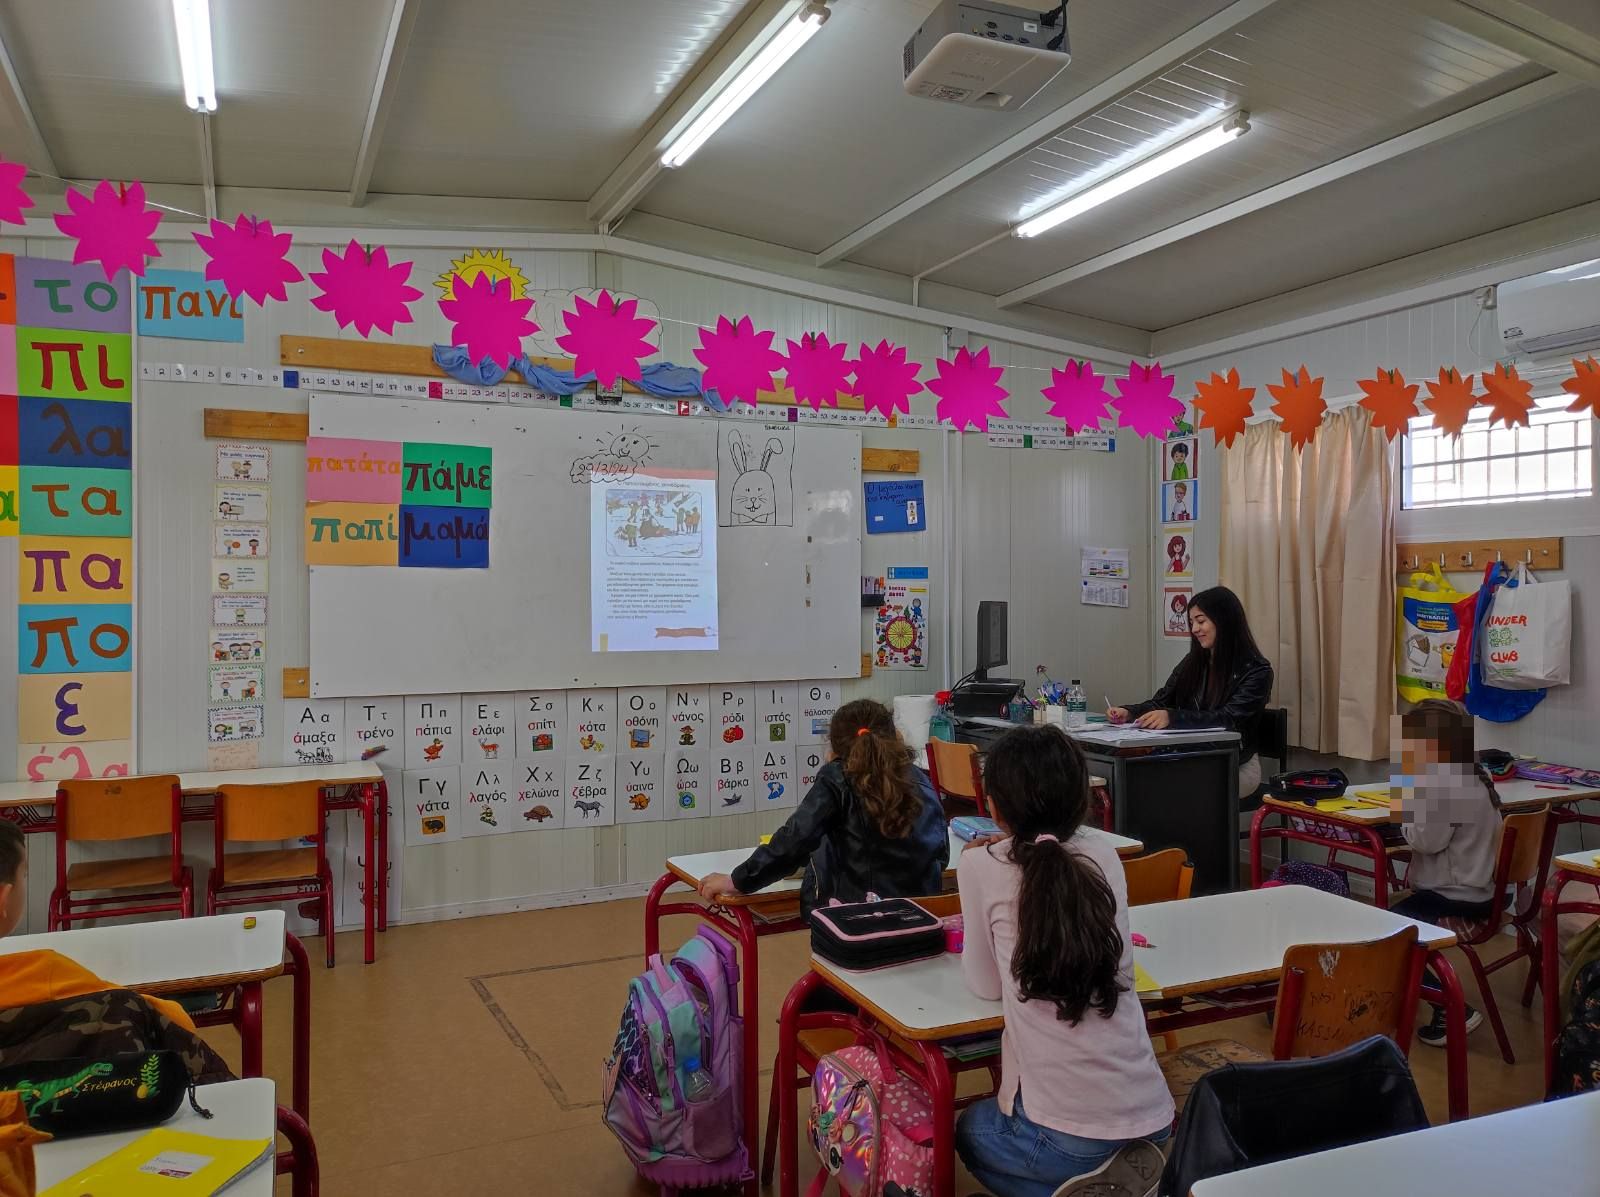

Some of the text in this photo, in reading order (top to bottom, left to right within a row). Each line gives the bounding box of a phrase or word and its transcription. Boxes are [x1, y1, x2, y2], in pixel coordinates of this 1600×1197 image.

[34, 279, 118, 313] το
[30, 341, 124, 391] πι
[175, 368, 182, 376] 3
[41, 402, 129, 457] λα
[577, 463, 629, 477] 29/3/24
[307, 452, 491, 503] πατάτα πάμε
[31, 484, 122, 518] τα
[310, 512, 489, 559] παπί μαμά
[24, 550, 124, 592] πα
[27, 617, 130, 669] πο
[1490, 650, 1519, 663] CLUB
[55, 682, 87, 736] ε
[626, 716, 659, 728] οθόνη
[672, 712, 704, 723] νάνος
[764, 712, 791, 723] ιστός
[415, 724, 452, 736] πάπια
[472, 724, 505, 737] ελάφι
[528, 719, 556, 730] σπίτι
[293, 731, 336, 745] άμαξα
[357, 726, 394, 741] τρένο
[763, 771, 788, 782] δόντι
[626, 782, 654, 792] ύαινα
[677, 779, 698, 791] ώρα
[717, 778, 749, 791] βάρκα
[469, 790, 507, 803] λαγός
[518, 788, 560, 801] χελώνα
[572, 786, 607, 799] ζέβρα
[417, 800, 450, 815] γάτα
[82, 1076, 138, 1093] Στέφανος
